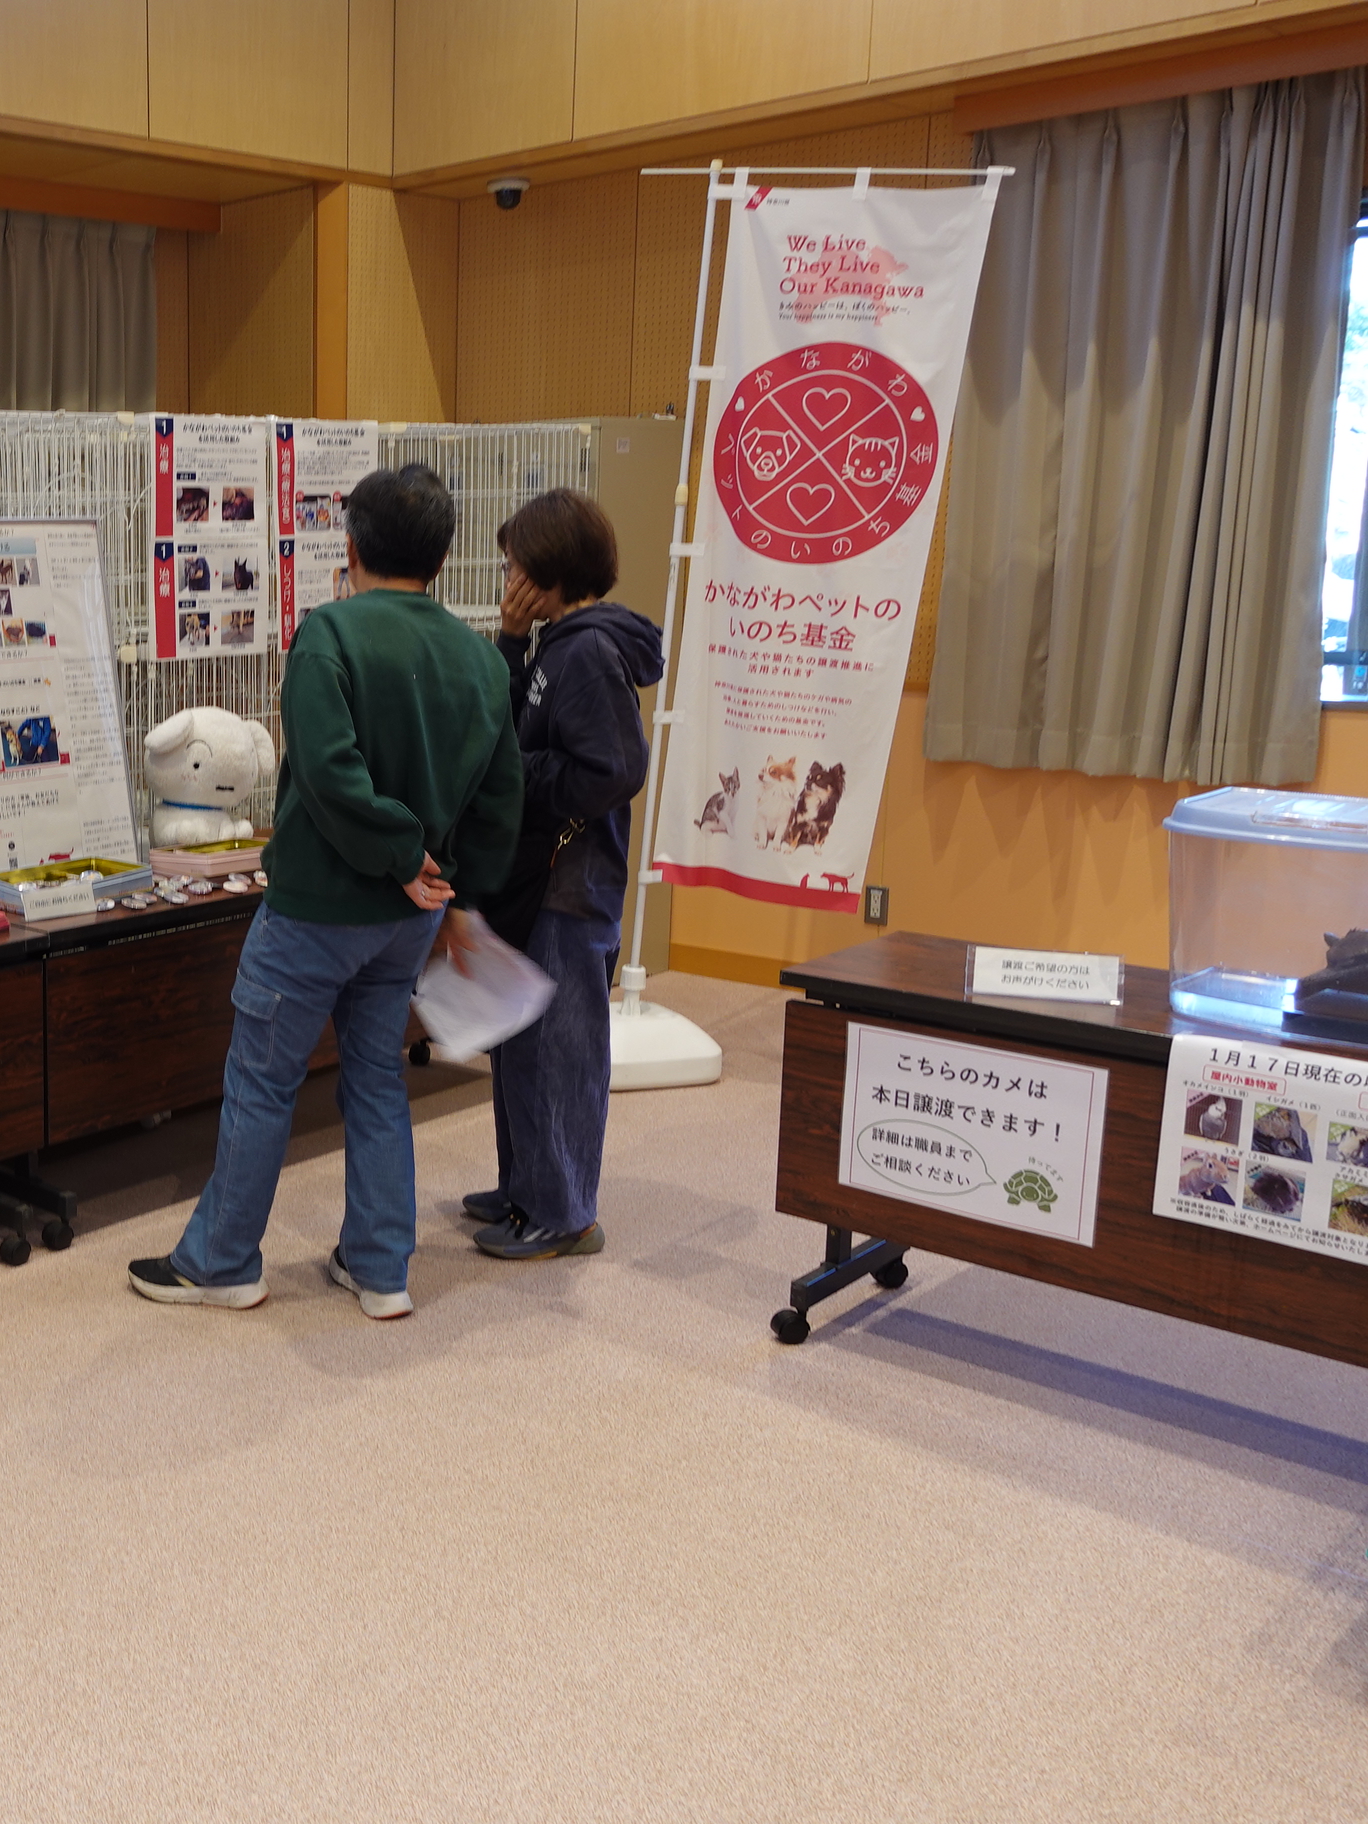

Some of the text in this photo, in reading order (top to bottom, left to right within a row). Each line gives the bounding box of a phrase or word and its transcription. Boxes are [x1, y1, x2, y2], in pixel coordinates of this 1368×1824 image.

[787, 234, 866, 252] We Live
[783, 255, 881, 278] They Live
[779, 277, 925, 301] Our Kanagawa
[704, 579, 902, 621] かながわペットの
[728, 616, 857, 652] いのち基金
[747, 664, 814, 679] 活用されます
[1000, 973, 1091, 991] お声がけください
[1001, 958, 1091, 976] 譲渡ご希望の方は
[897, 1052, 1048, 1100] こちらのカメは
[1209, 1048, 1368, 1088] 1月17日現在の
[1210, 1070, 1279, 1092] 屋内小動物室
[871, 1085, 1062, 1143] 本日譲渡できます！
[872, 1127, 973, 1163] 詳細は職員まで
[870, 1152, 971, 1188] ご相談ください
